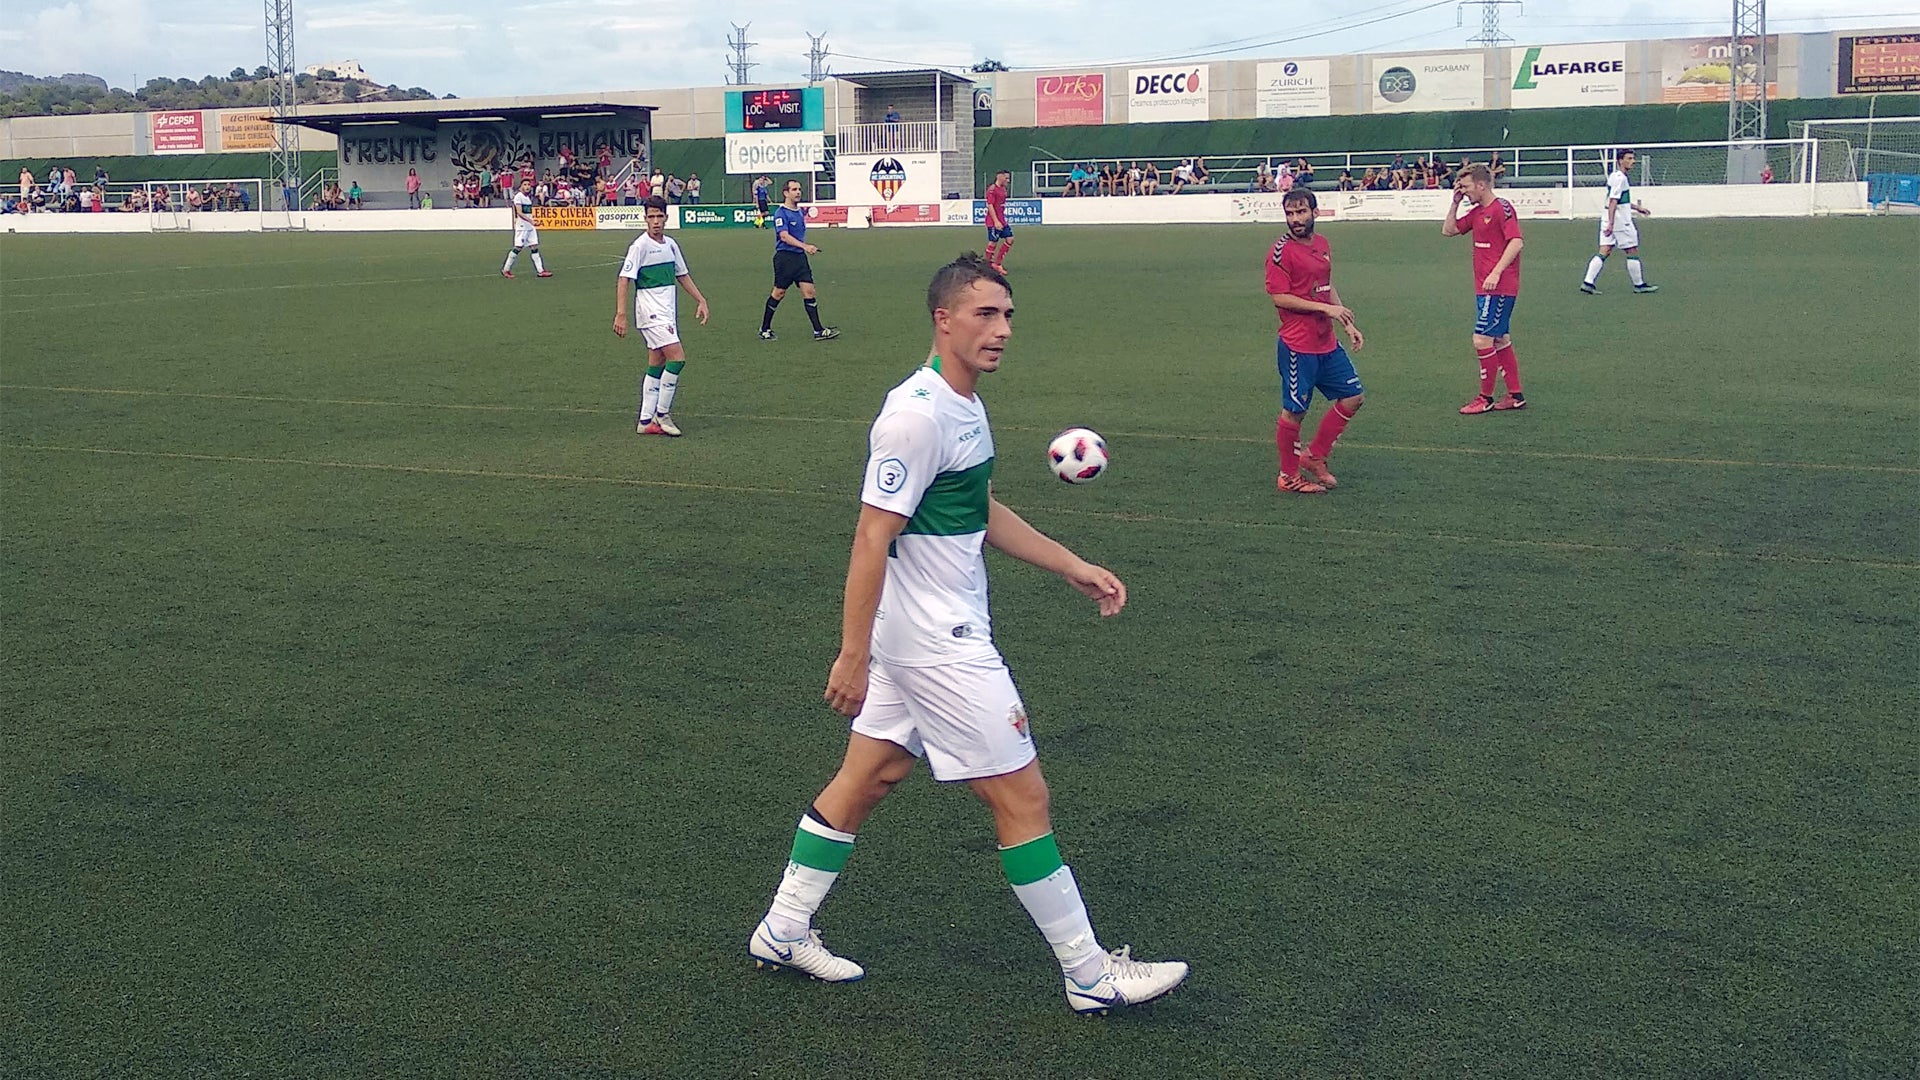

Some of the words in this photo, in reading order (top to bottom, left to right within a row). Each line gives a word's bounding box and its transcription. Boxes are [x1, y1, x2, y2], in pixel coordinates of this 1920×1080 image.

[1533, 60, 1623, 76] LAFARGE
[1042, 76, 1102, 101] Urky
[1271, 78, 1313, 87] ZURICH
[745, 105, 765, 115] LOC.
[779, 103, 801, 114] VISIT.
[168, 116, 195, 126] CEPSA
[538, 128, 645, 159] ROMANO
[343, 137, 438, 164] FRENTE
[533, 207, 558, 219] ERES
[560, 207, 594, 218] CIVERA
[598, 212, 640, 223] gasoprix
[947, 213, 969, 221] activa
[1026, 207, 1041, 216] S.L.
[546, 219, 553, 227] Y
[554, 219, 594, 227] PINTURA
[958, 426, 982, 443] KELME
